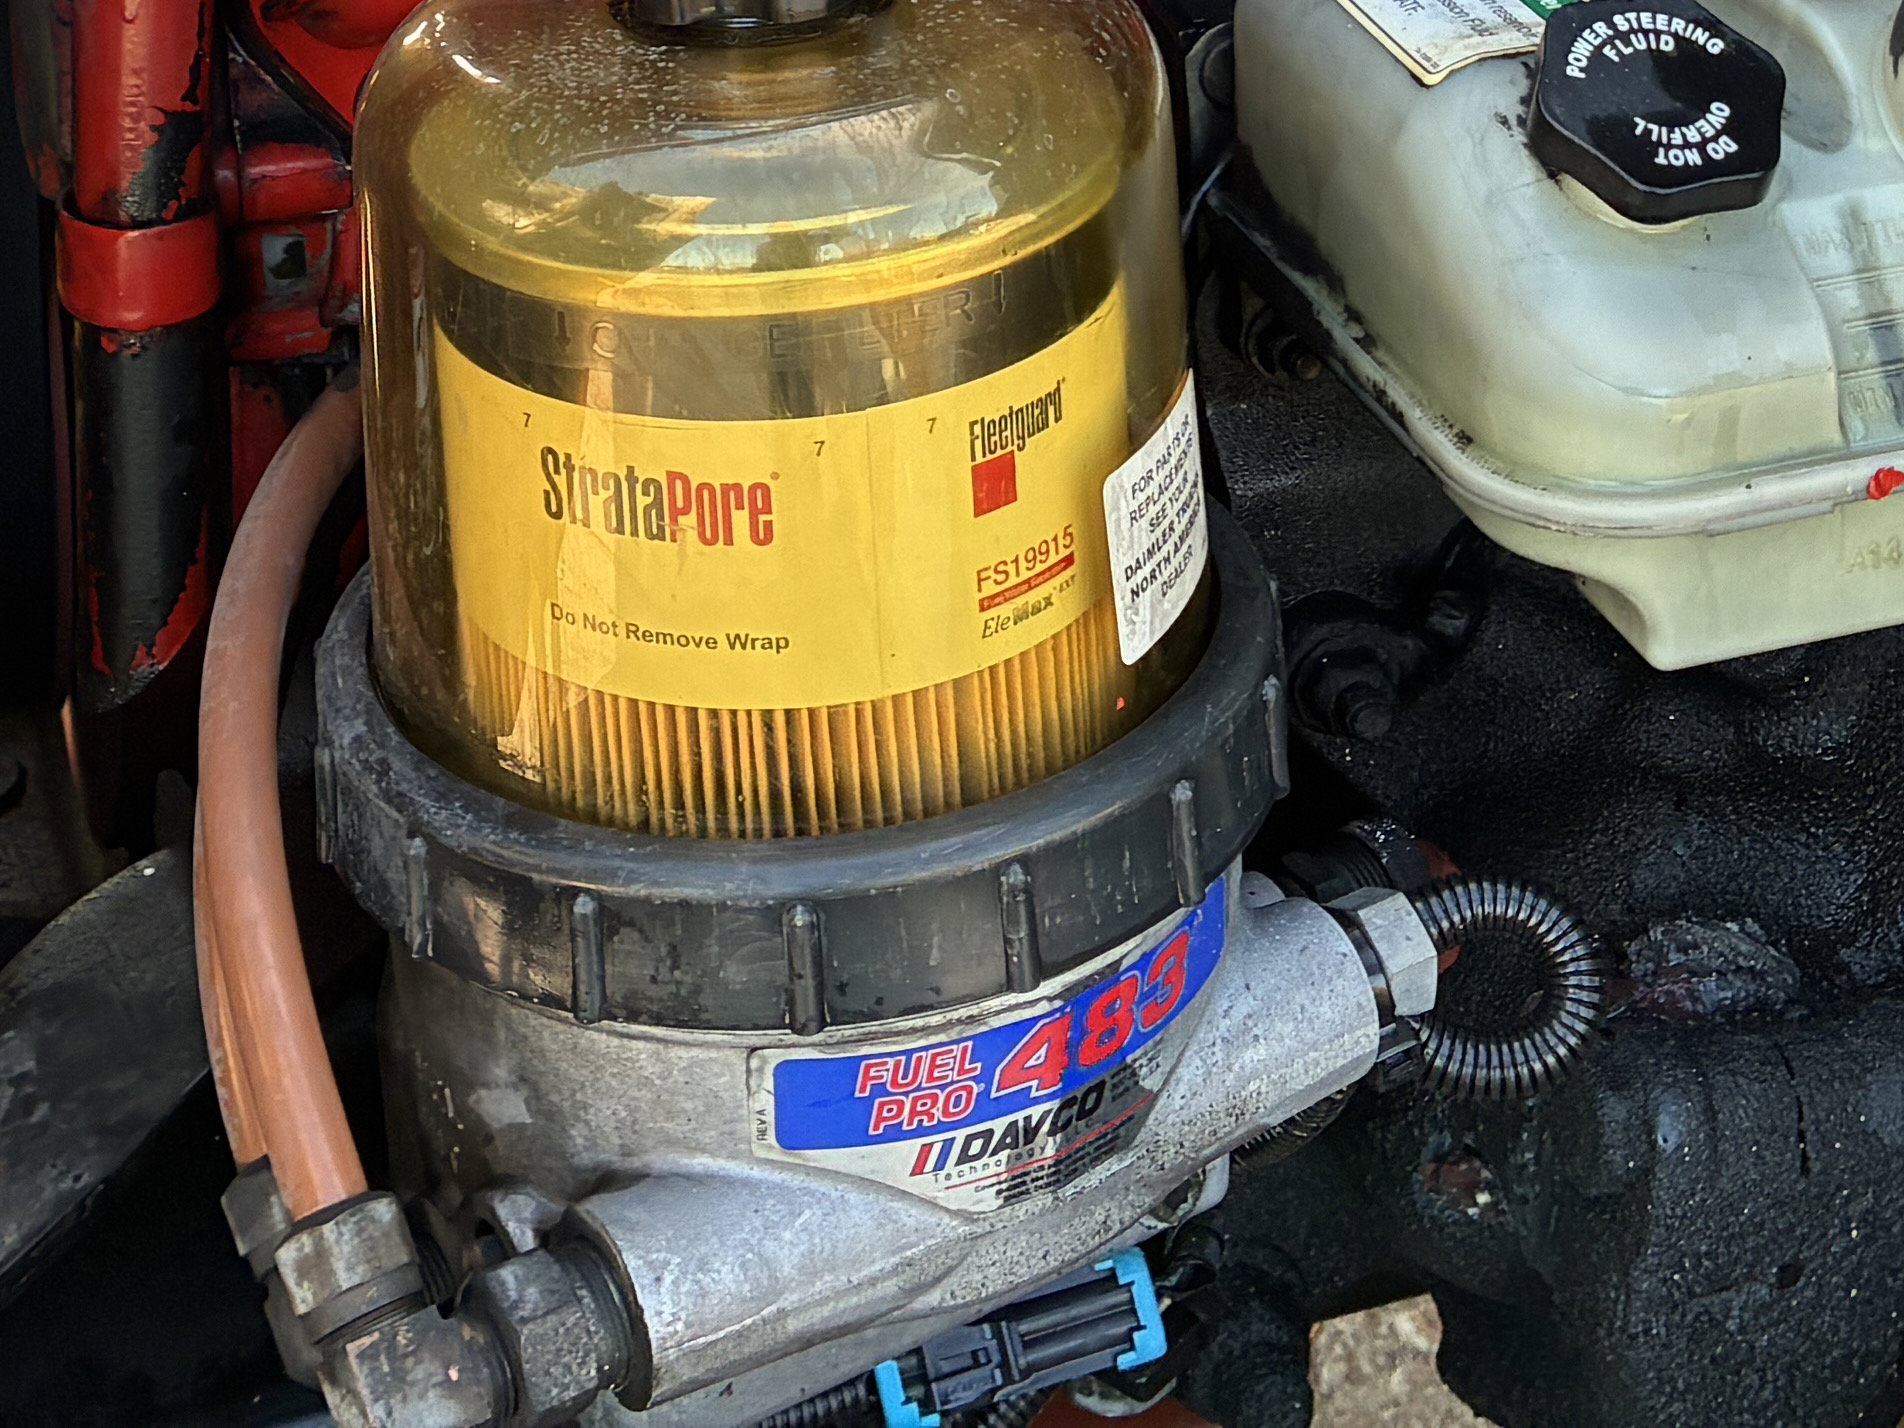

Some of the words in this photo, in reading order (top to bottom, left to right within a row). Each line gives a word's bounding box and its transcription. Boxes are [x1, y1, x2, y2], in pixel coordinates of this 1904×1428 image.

[1565, 21, 1614, 79] POWER
[1612, 12, 1725, 55] STEERING
[1602, 33, 1675, 63] FLUID
[1633, 101, 1731, 145] OVERFILL
[1706, 135, 1739, 161] DO
[1654, 146, 1703, 167] NOT
[522, 411, 533, 428] 7
[927, 417, 938, 434] 7
[968, 378, 1066, 463] Fleetguard
[813, 440, 824, 456] 7
[539, 446, 775, 548] StrataPore
[1131, 467, 1156, 501] FOR
[1149, 505, 1169, 533] SEE
[976, 523, 1075, 593] FS19915
[1124, 519, 1176, 582] DAIMLER
[1159, 543, 1194, 598] DEALER
[1130, 552, 1172, 603] NORTH
[550, 601, 578, 628] Do
[583, 609, 620, 639] Not
[624, 620, 719, 652] Remove
[725, 629, 791, 657] Wrap
[989, 927, 1191, 1100] 483
[855, 1039, 982, 1098] FUEL
[868, 1083, 978, 1136] PRO
[954, 1080, 1107, 1167] DAVCO
